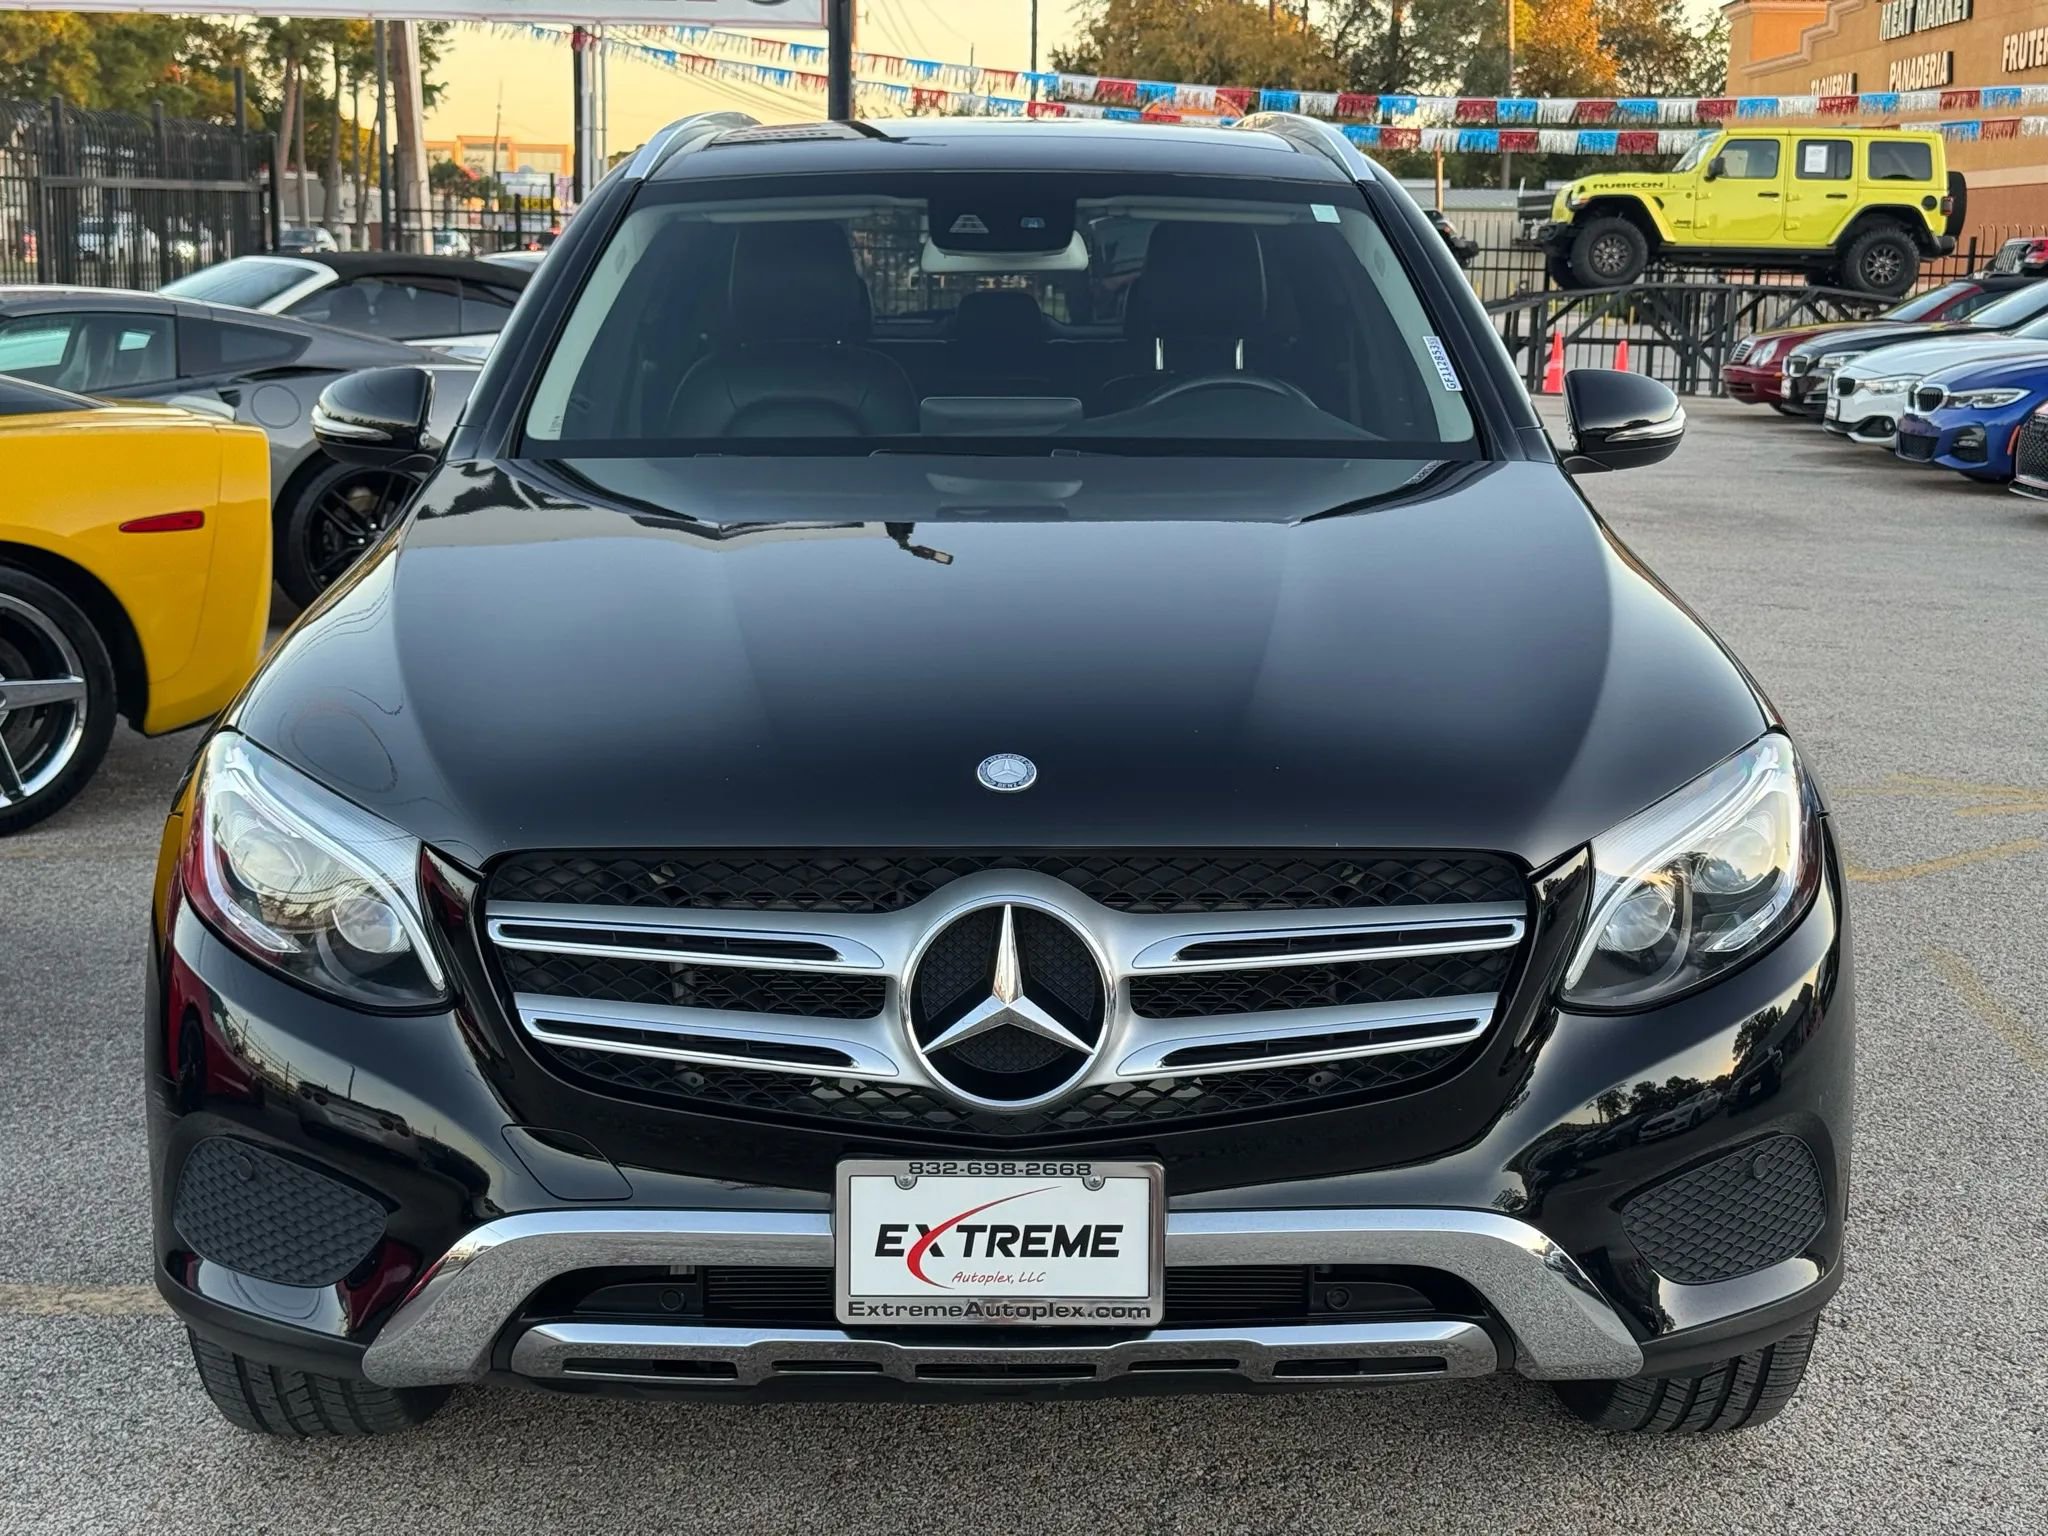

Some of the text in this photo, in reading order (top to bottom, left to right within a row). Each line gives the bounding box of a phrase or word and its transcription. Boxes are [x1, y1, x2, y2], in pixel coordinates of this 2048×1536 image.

[1879, 0, 1914, 41] MEAT
[1889, 50, 1949, 93] PANADERIA
[909, 1162, 1092, 1176] 832-698-2668
[875, 1223, 1124, 1258] EXTREME
[951, 1271, 1047, 1286] Autoplex, LLC
[848, 1301, 1151, 1321] ExtremeAutoplex.com
